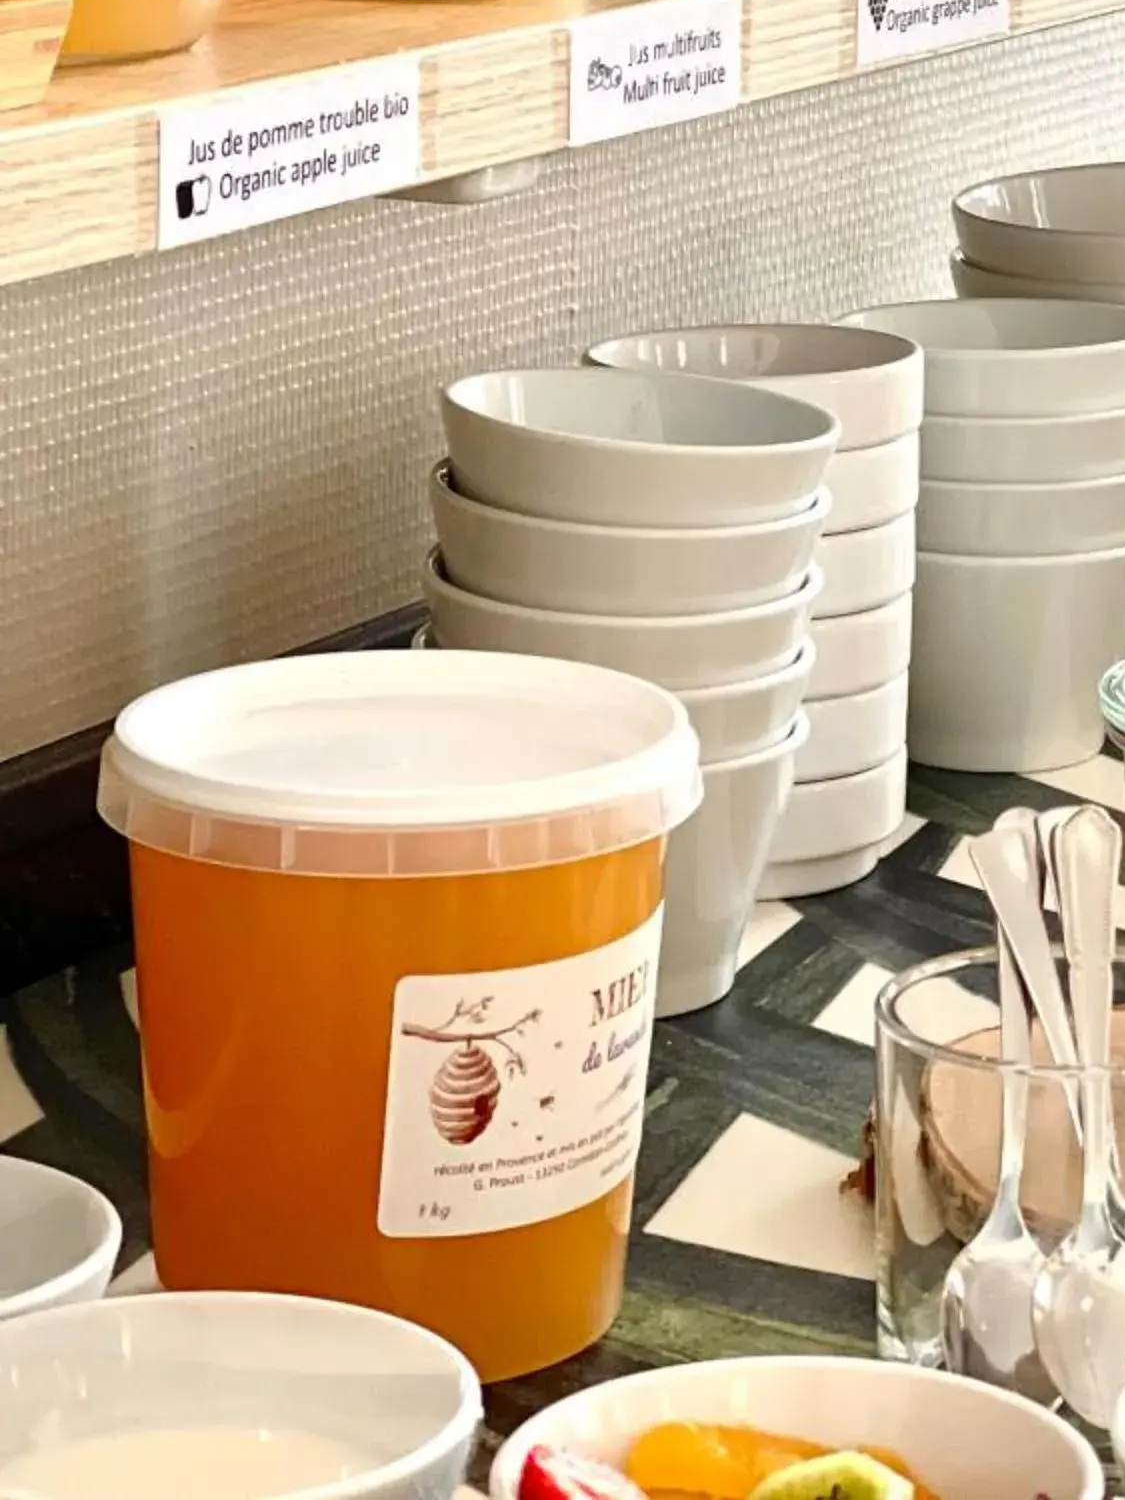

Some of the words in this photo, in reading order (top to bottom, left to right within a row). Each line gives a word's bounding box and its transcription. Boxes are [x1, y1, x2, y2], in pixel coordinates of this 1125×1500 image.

[886, 2, 930, 33] Organic
[627, 41, 649, 67] Jus
[653, 28, 721, 61] multifruits
[623, 73, 659, 105] Multi
[663, 67, 691, 96] fruit
[693, 62, 726, 95] juice
[188, 139, 216, 166] Jus
[221, 129, 243, 159] de
[248, 119, 315, 158] pomme
[319, 99, 379, 135] trouble
[383, 92, 409, 120] bio
[219, 163, 287, 202] Organic
[291, 147, 337, 187] apple
[341, 142, 381, 177] juice
[582, 1040, 603, 1074] de
[495, 1151, 545, 1172] Provence
[430, 1199, 451, 1221] kg
